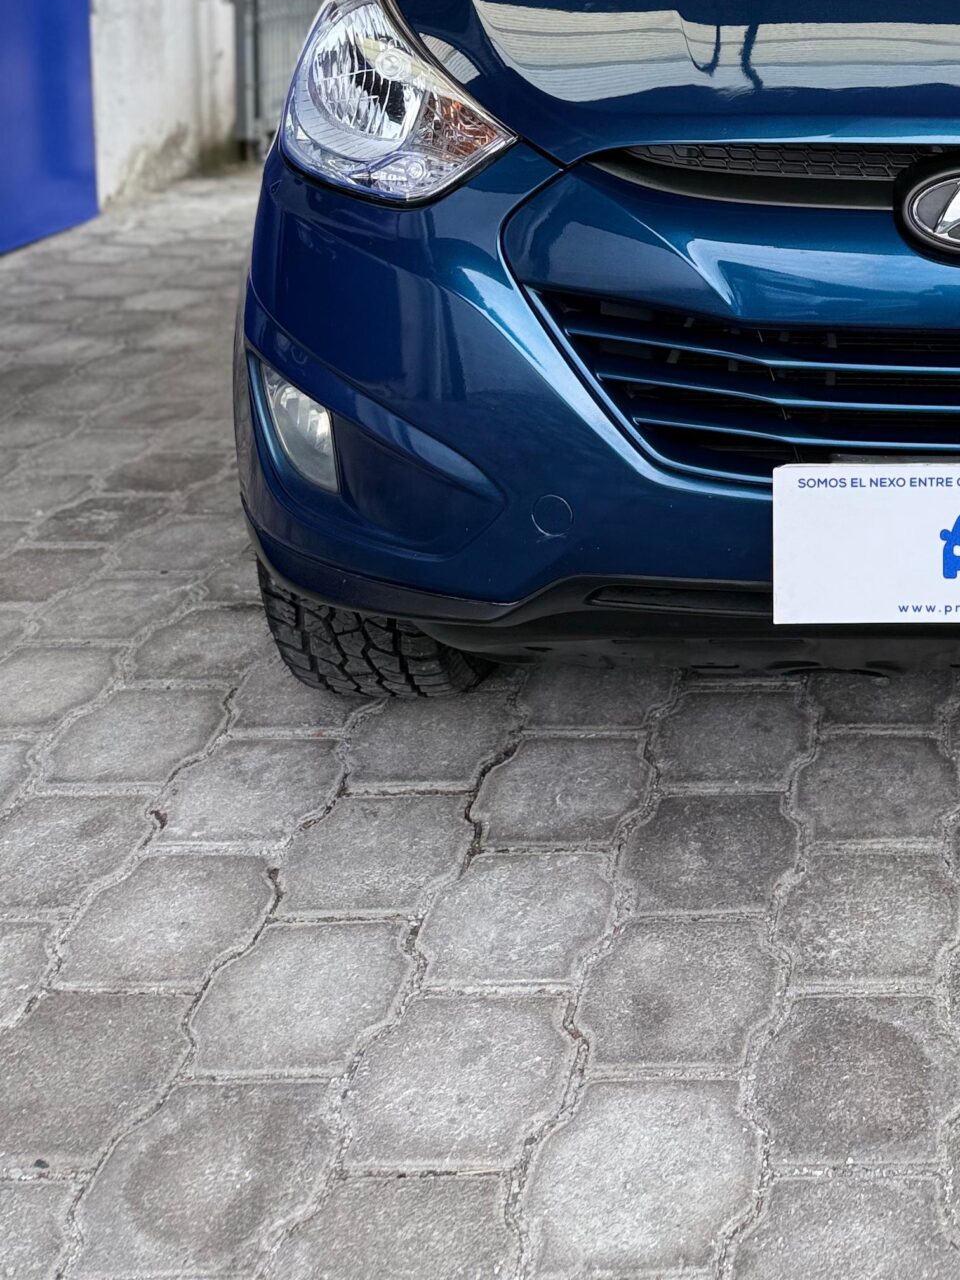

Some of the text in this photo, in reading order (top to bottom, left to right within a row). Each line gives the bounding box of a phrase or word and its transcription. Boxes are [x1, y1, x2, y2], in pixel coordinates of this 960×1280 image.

[797, 477, 847, 489] SOMOS
[850, 477, 866, 488] EL
[869, 477, 906, 488] NEXO
[909, 477, 953, 488] ENTRE
